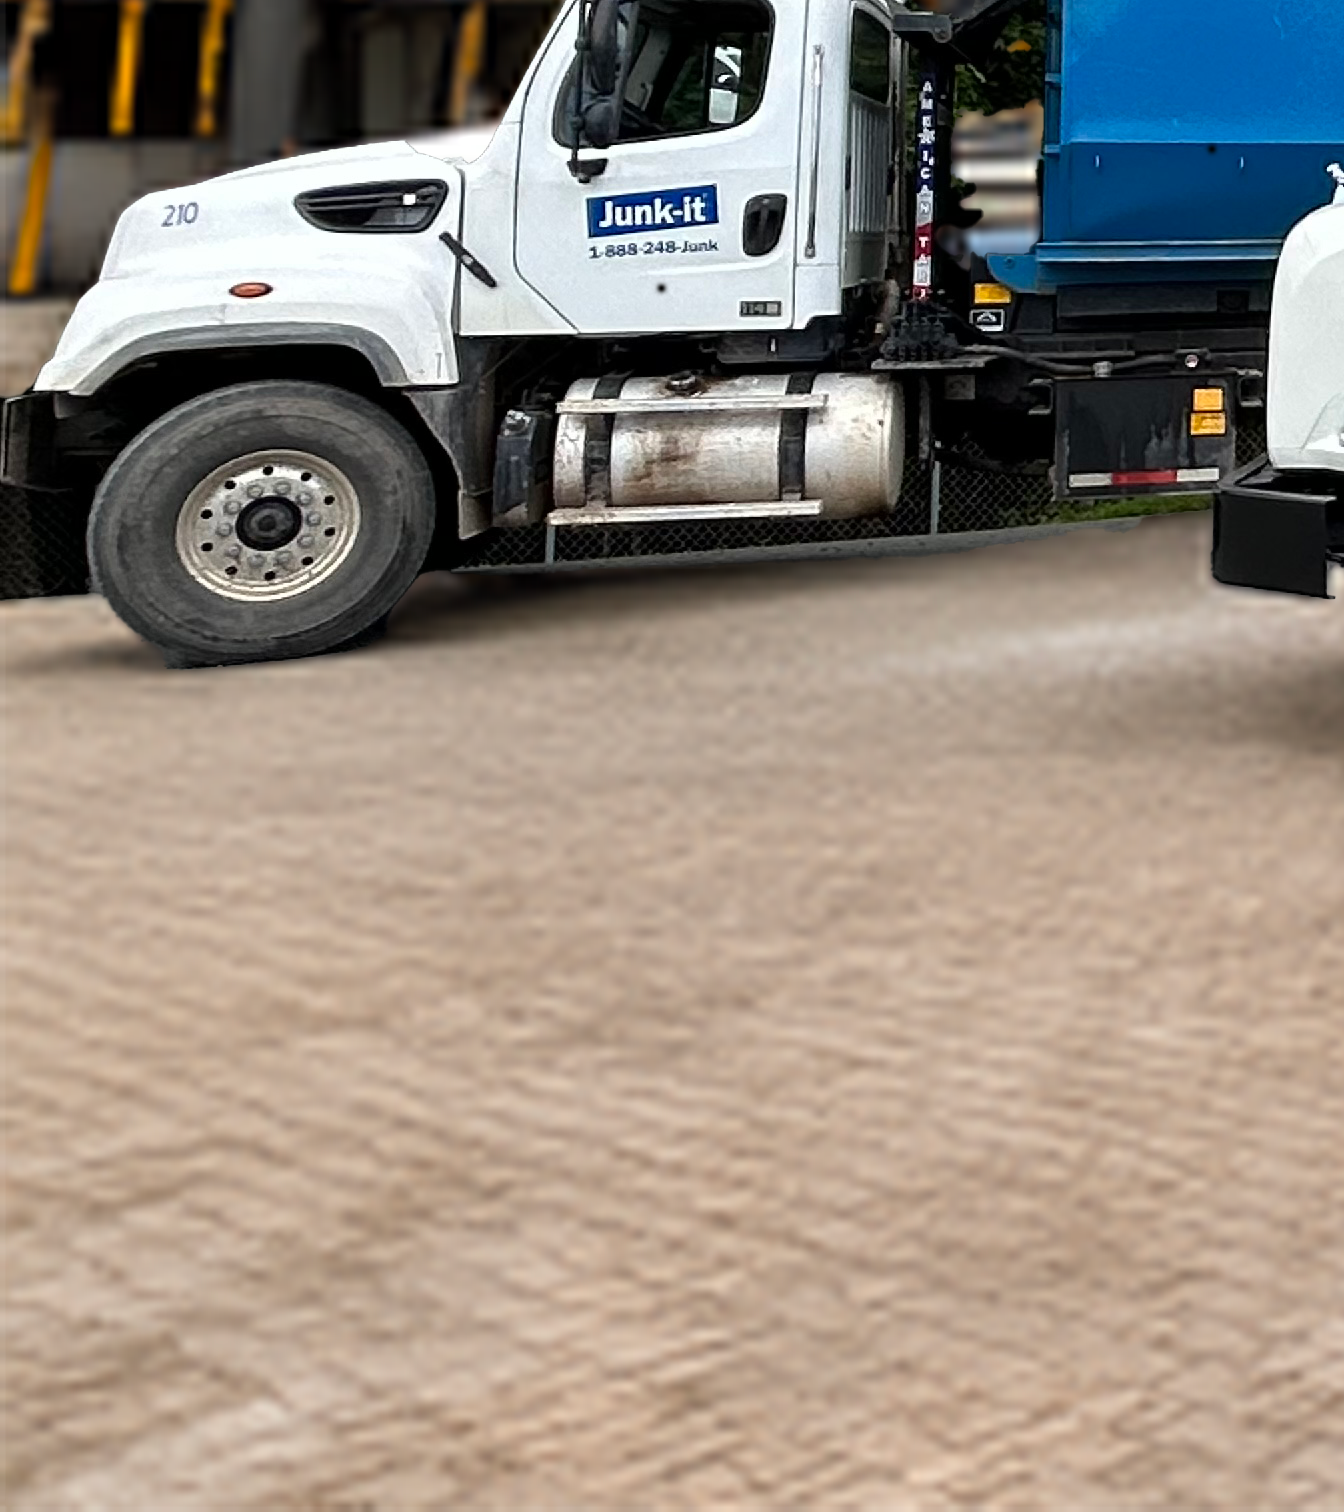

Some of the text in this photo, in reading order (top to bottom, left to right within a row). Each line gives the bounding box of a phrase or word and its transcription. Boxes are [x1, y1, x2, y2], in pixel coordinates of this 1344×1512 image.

[160, 201, 199, 228] 210
[598, 194, 707, 229] Junk-it
[588, 237, 720, 259] 1-888-248-Junk
